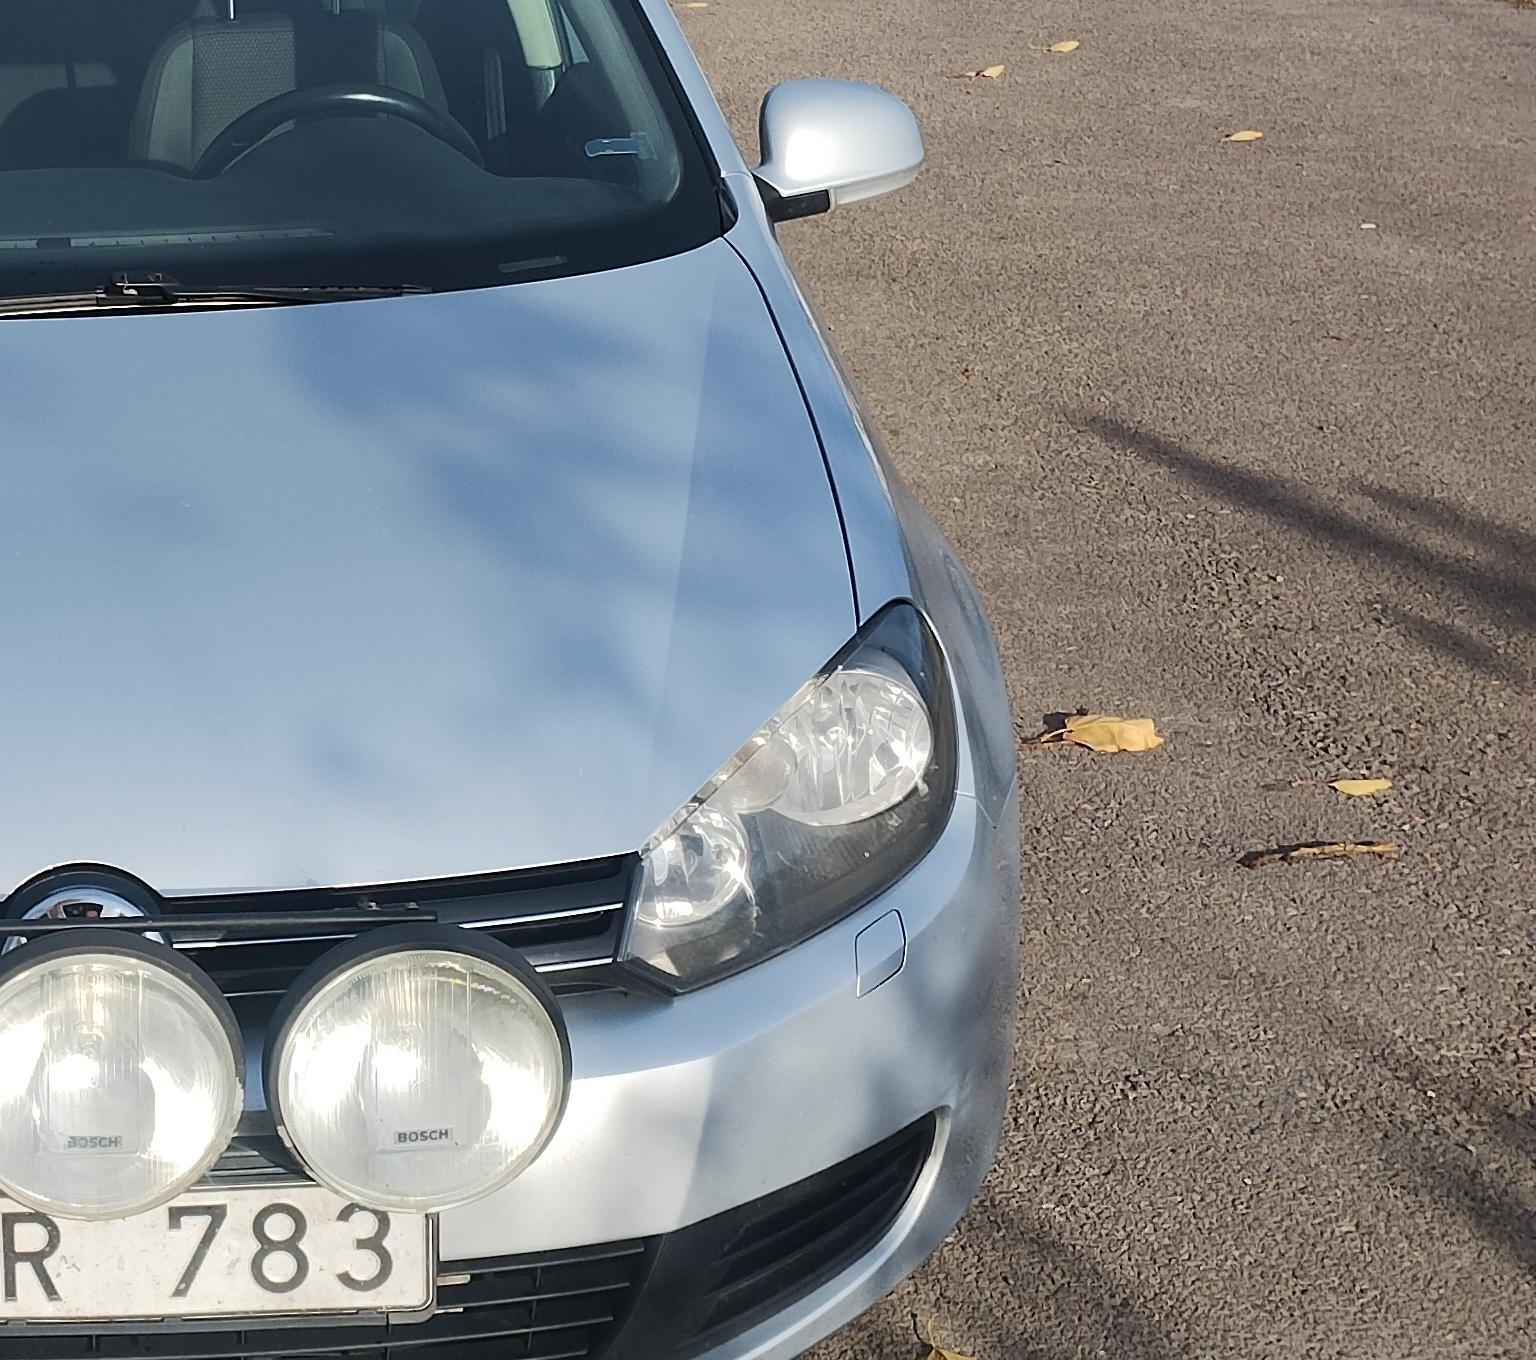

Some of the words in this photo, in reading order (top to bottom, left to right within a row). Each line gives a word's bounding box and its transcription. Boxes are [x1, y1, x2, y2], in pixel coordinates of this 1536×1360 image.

[67, 1135, 119, 1149] BOSCH
[397, 1128, 449, 1143] BOSCH
[167, 1201, 394, 1299] 783
